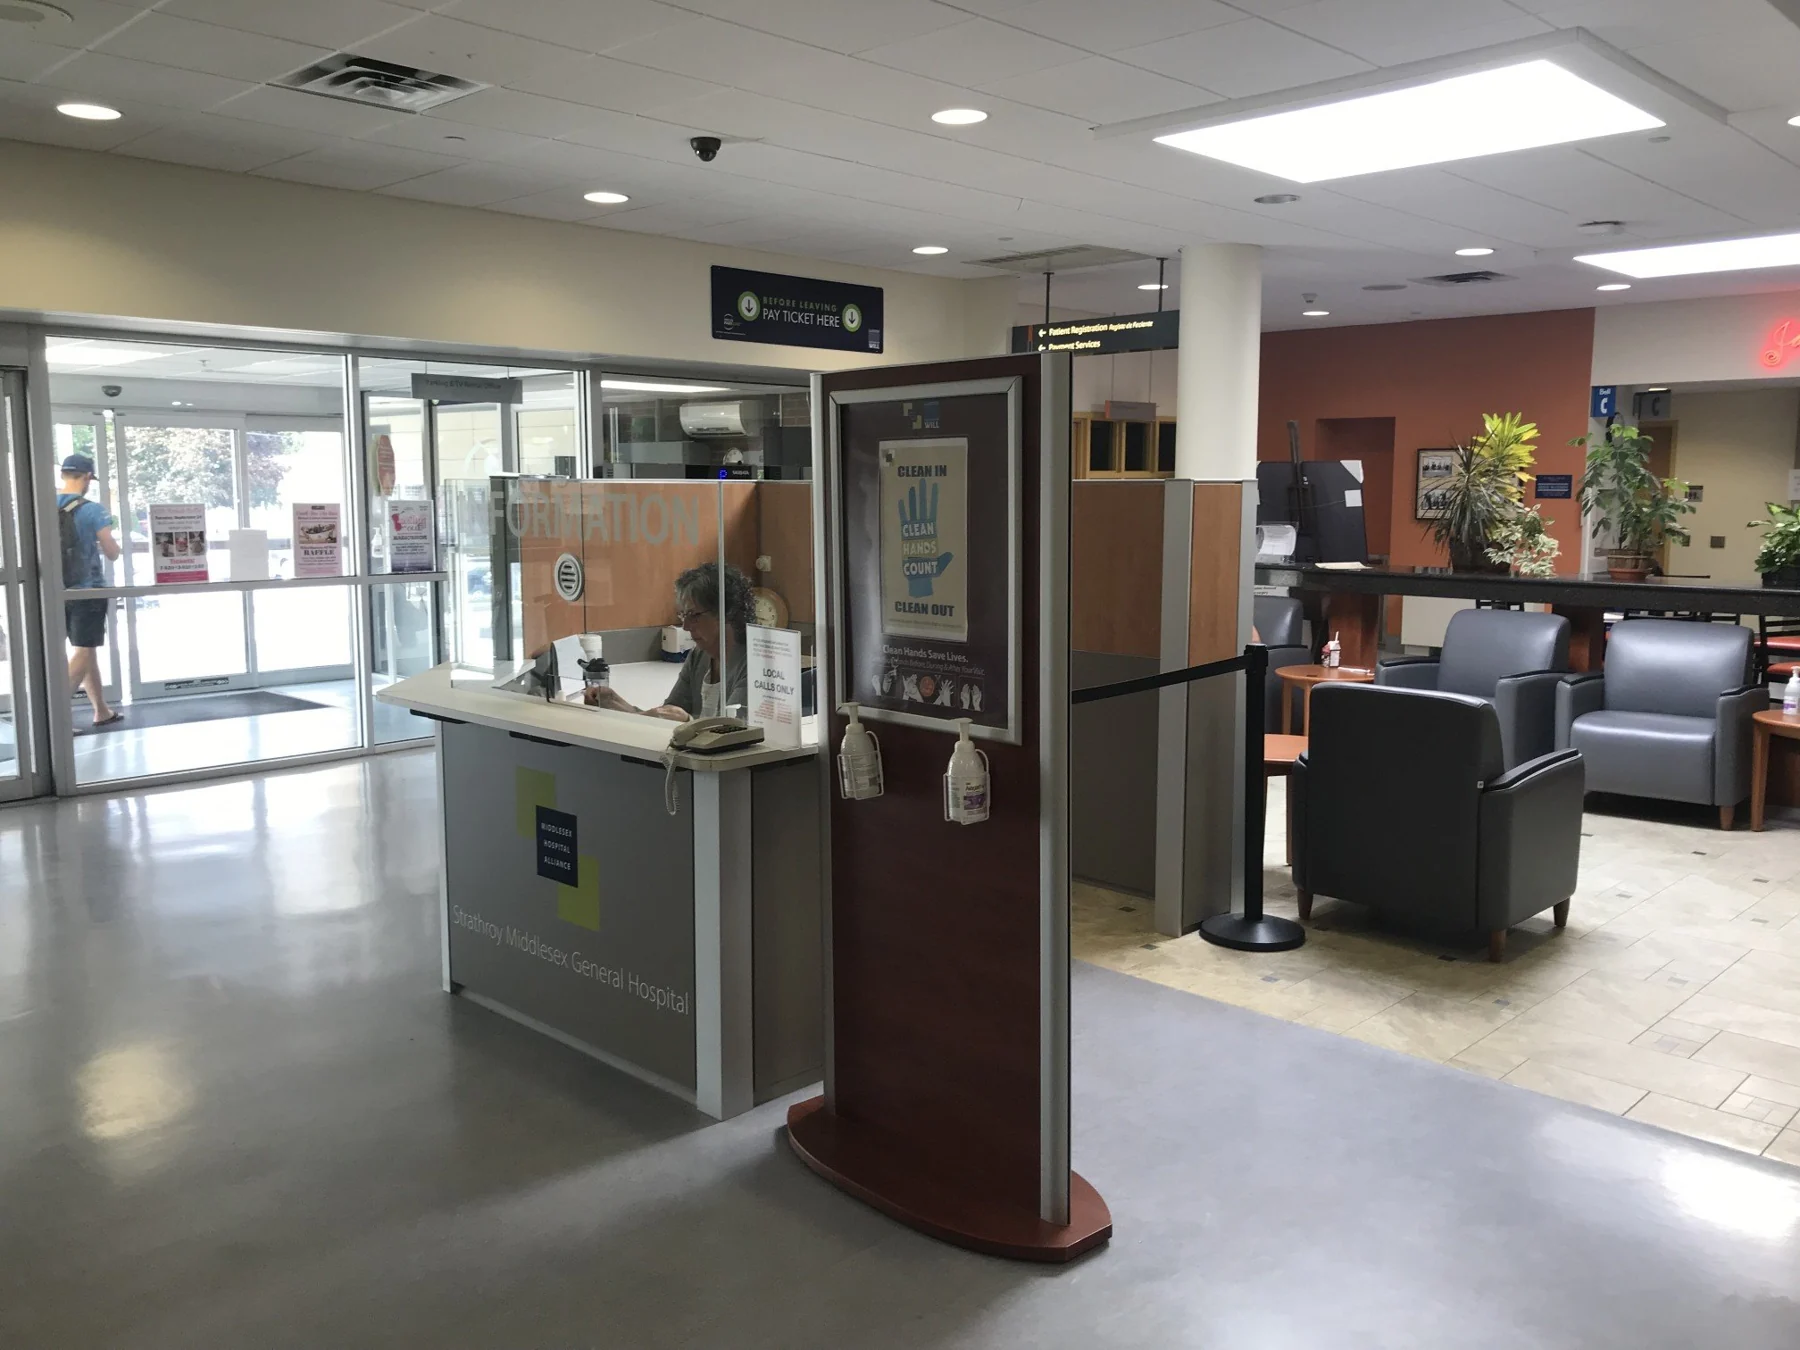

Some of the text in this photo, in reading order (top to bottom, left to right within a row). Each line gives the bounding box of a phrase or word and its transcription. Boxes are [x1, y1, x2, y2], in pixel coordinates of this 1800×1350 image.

[763, 297, 837, 312] BEFORE LEAVING
[763, 308, 840, 328] PAY TICKET HERE
[1048, 326, 1070, 336] Patient
[1071, 323, 1108, 335] Registration
[1075, 340, 1100, 349] Services
[924, 420, 940, 429] WILL
[897, 465, 947, 477] CLEAN IN
[458, 489, 698, 546] INFORMATION
[902, 522, 934, 537] CLEAN
[903, 541, 937, 556] HANDS
[903, 561, 938, 576] COUNT
[895, 601, 954, 617] CLEAN OUT
[882, 644, 969, 663] Clean Hands Save Lives.
[763, 668, 785, 680] LOCAL
[754, 680, 794, 695] CALLS ONLY
[540, 822, 572, 838] MIDDLESEX
[544, 839, 570, 854] HOSPITAL
[543, 856, 571, 871] ALLIANCE
[452, 904, 689, 1015] Strathroy Middlesex General Hospital
